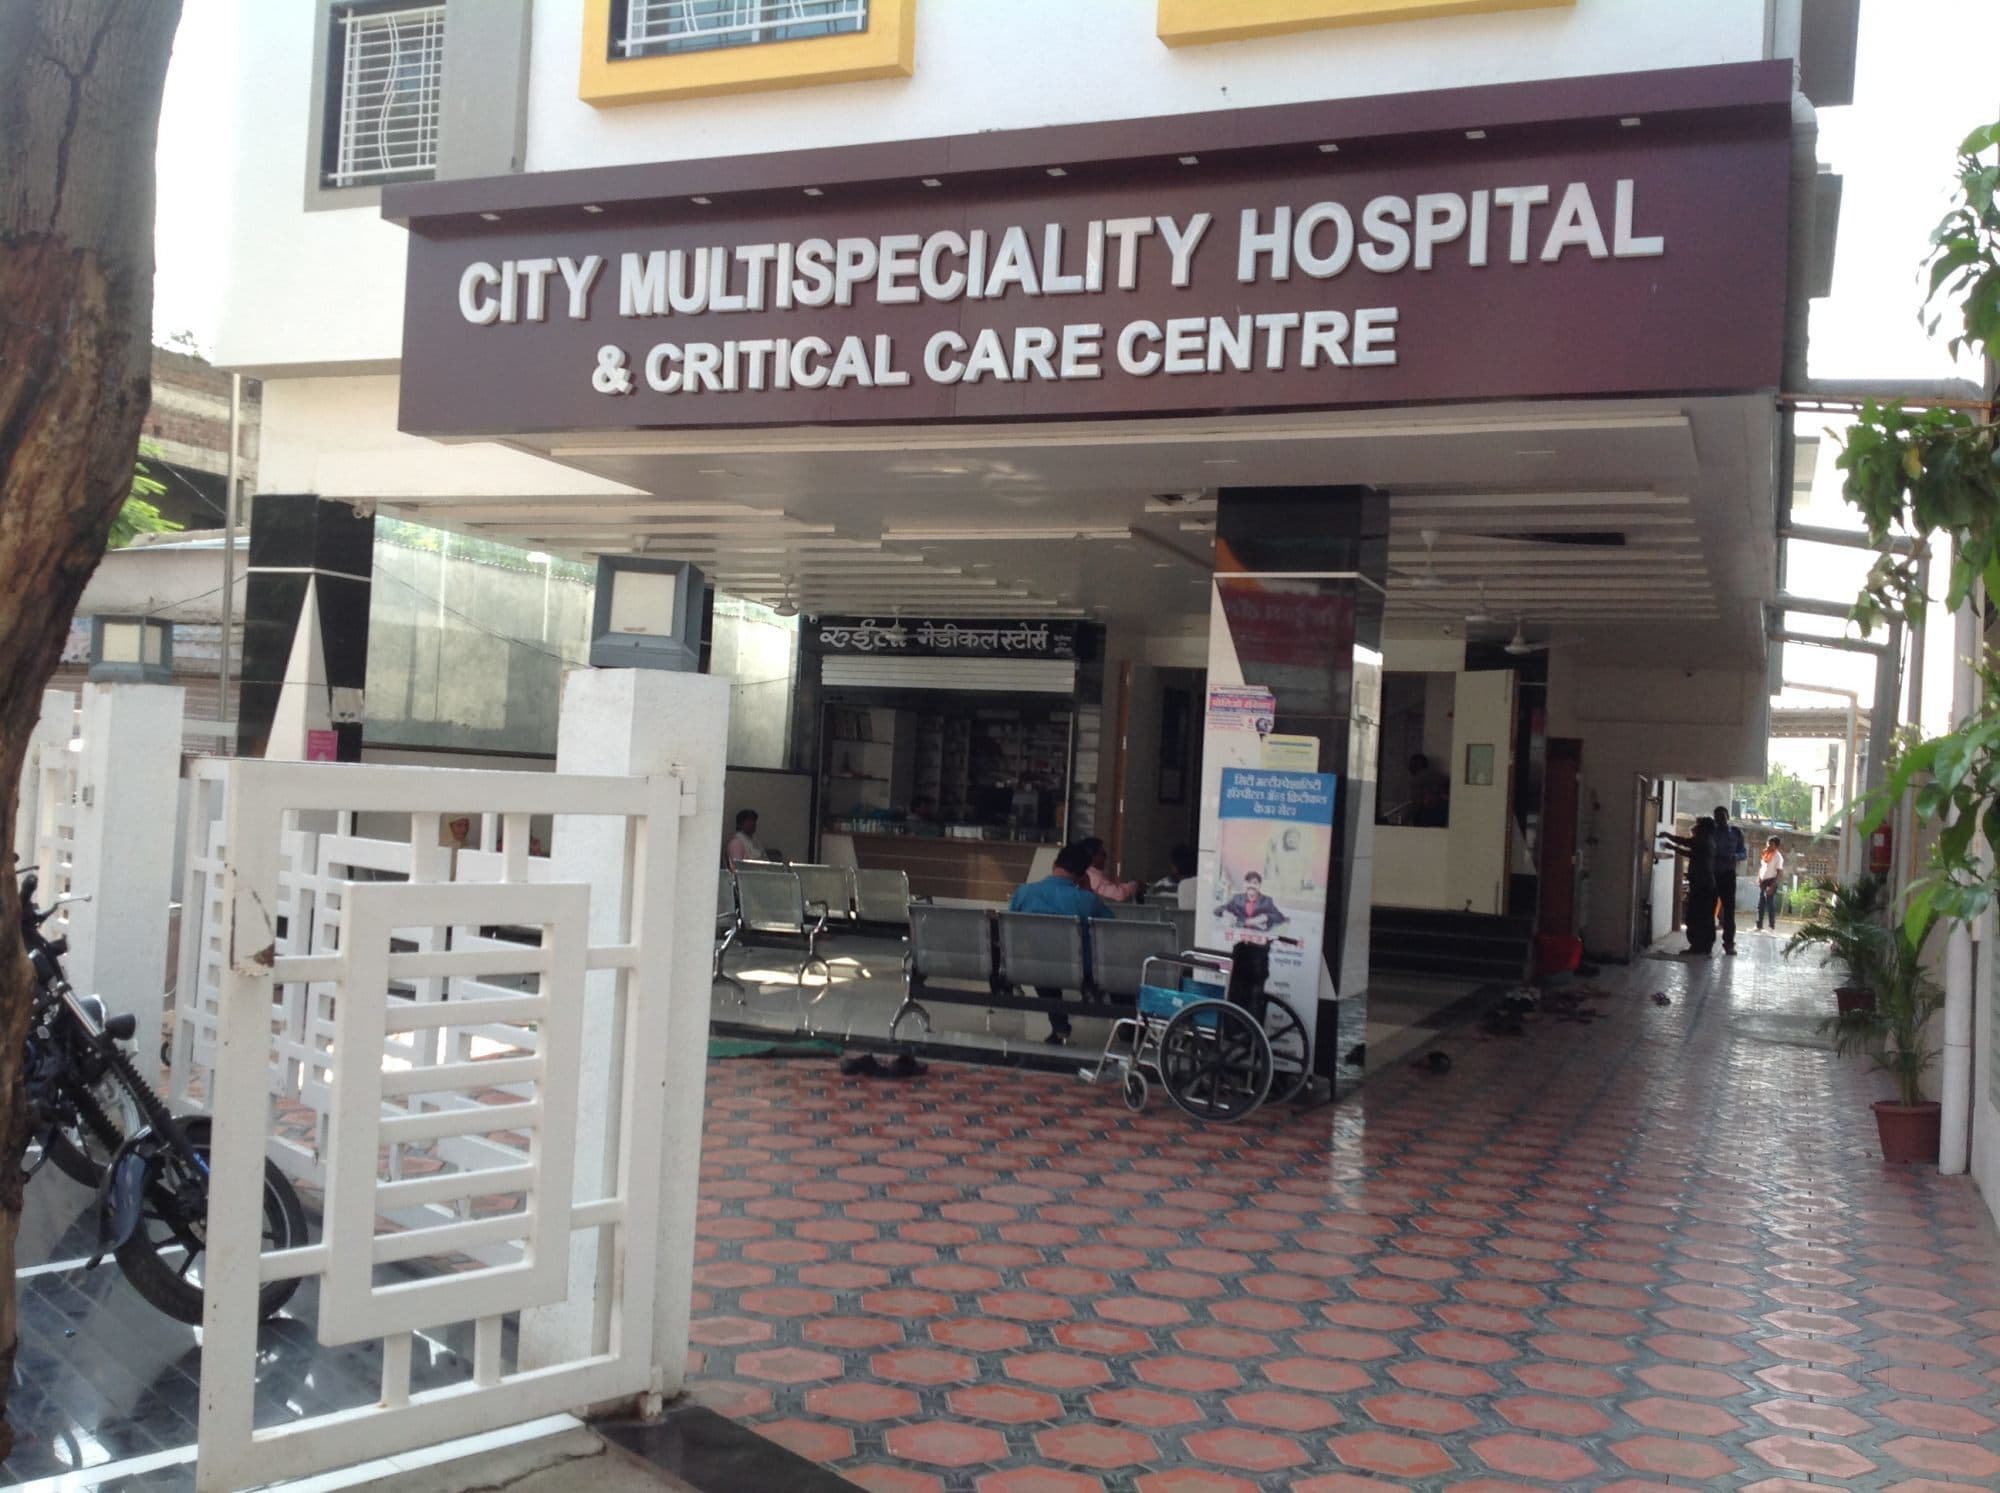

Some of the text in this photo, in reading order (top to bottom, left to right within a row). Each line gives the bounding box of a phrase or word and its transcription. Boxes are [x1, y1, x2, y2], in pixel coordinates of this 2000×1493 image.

[458, 178, 1665, 326] CITY MULTISPECIALITY HOSPITAL
[591, 307, 1399, 396] & CRITICAL CARE CENTRE
